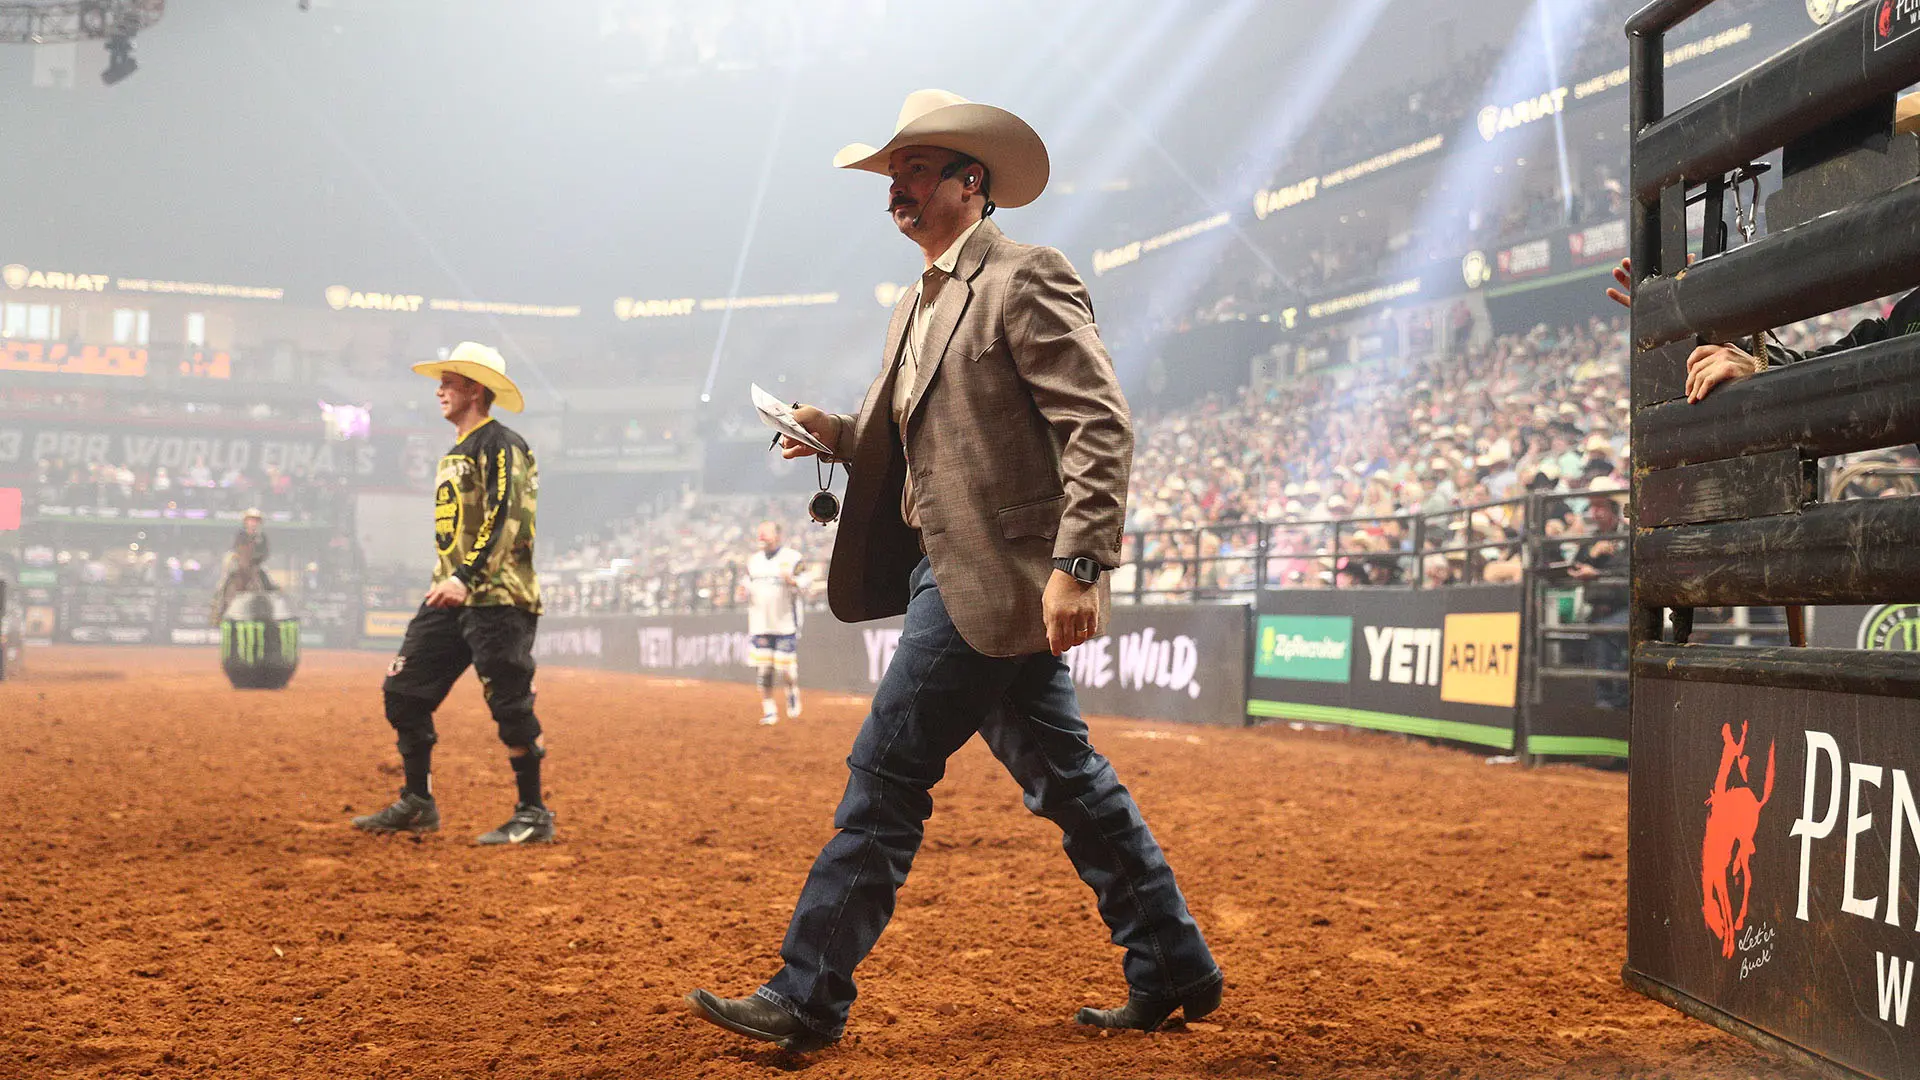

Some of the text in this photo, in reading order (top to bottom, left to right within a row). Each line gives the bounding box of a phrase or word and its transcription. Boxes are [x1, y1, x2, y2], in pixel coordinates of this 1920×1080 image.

[1498, 87, 1568, 132] ARIAT
[1267, 176, 1319, 213] ARIAT
[27, 271, 109, 291] ARIAT
[349, 291, 423, 311] ARIAT
[631, 298, 696, 318] ARIAT
[122, 436, 249, 472] WORLD
[260, 440, 376, 480] FINAS
[1364, 626, 1441, 686] YETI
[1448, 643, 1513, 675] ARIAT
[1876, 951, 1914, 1027] W
